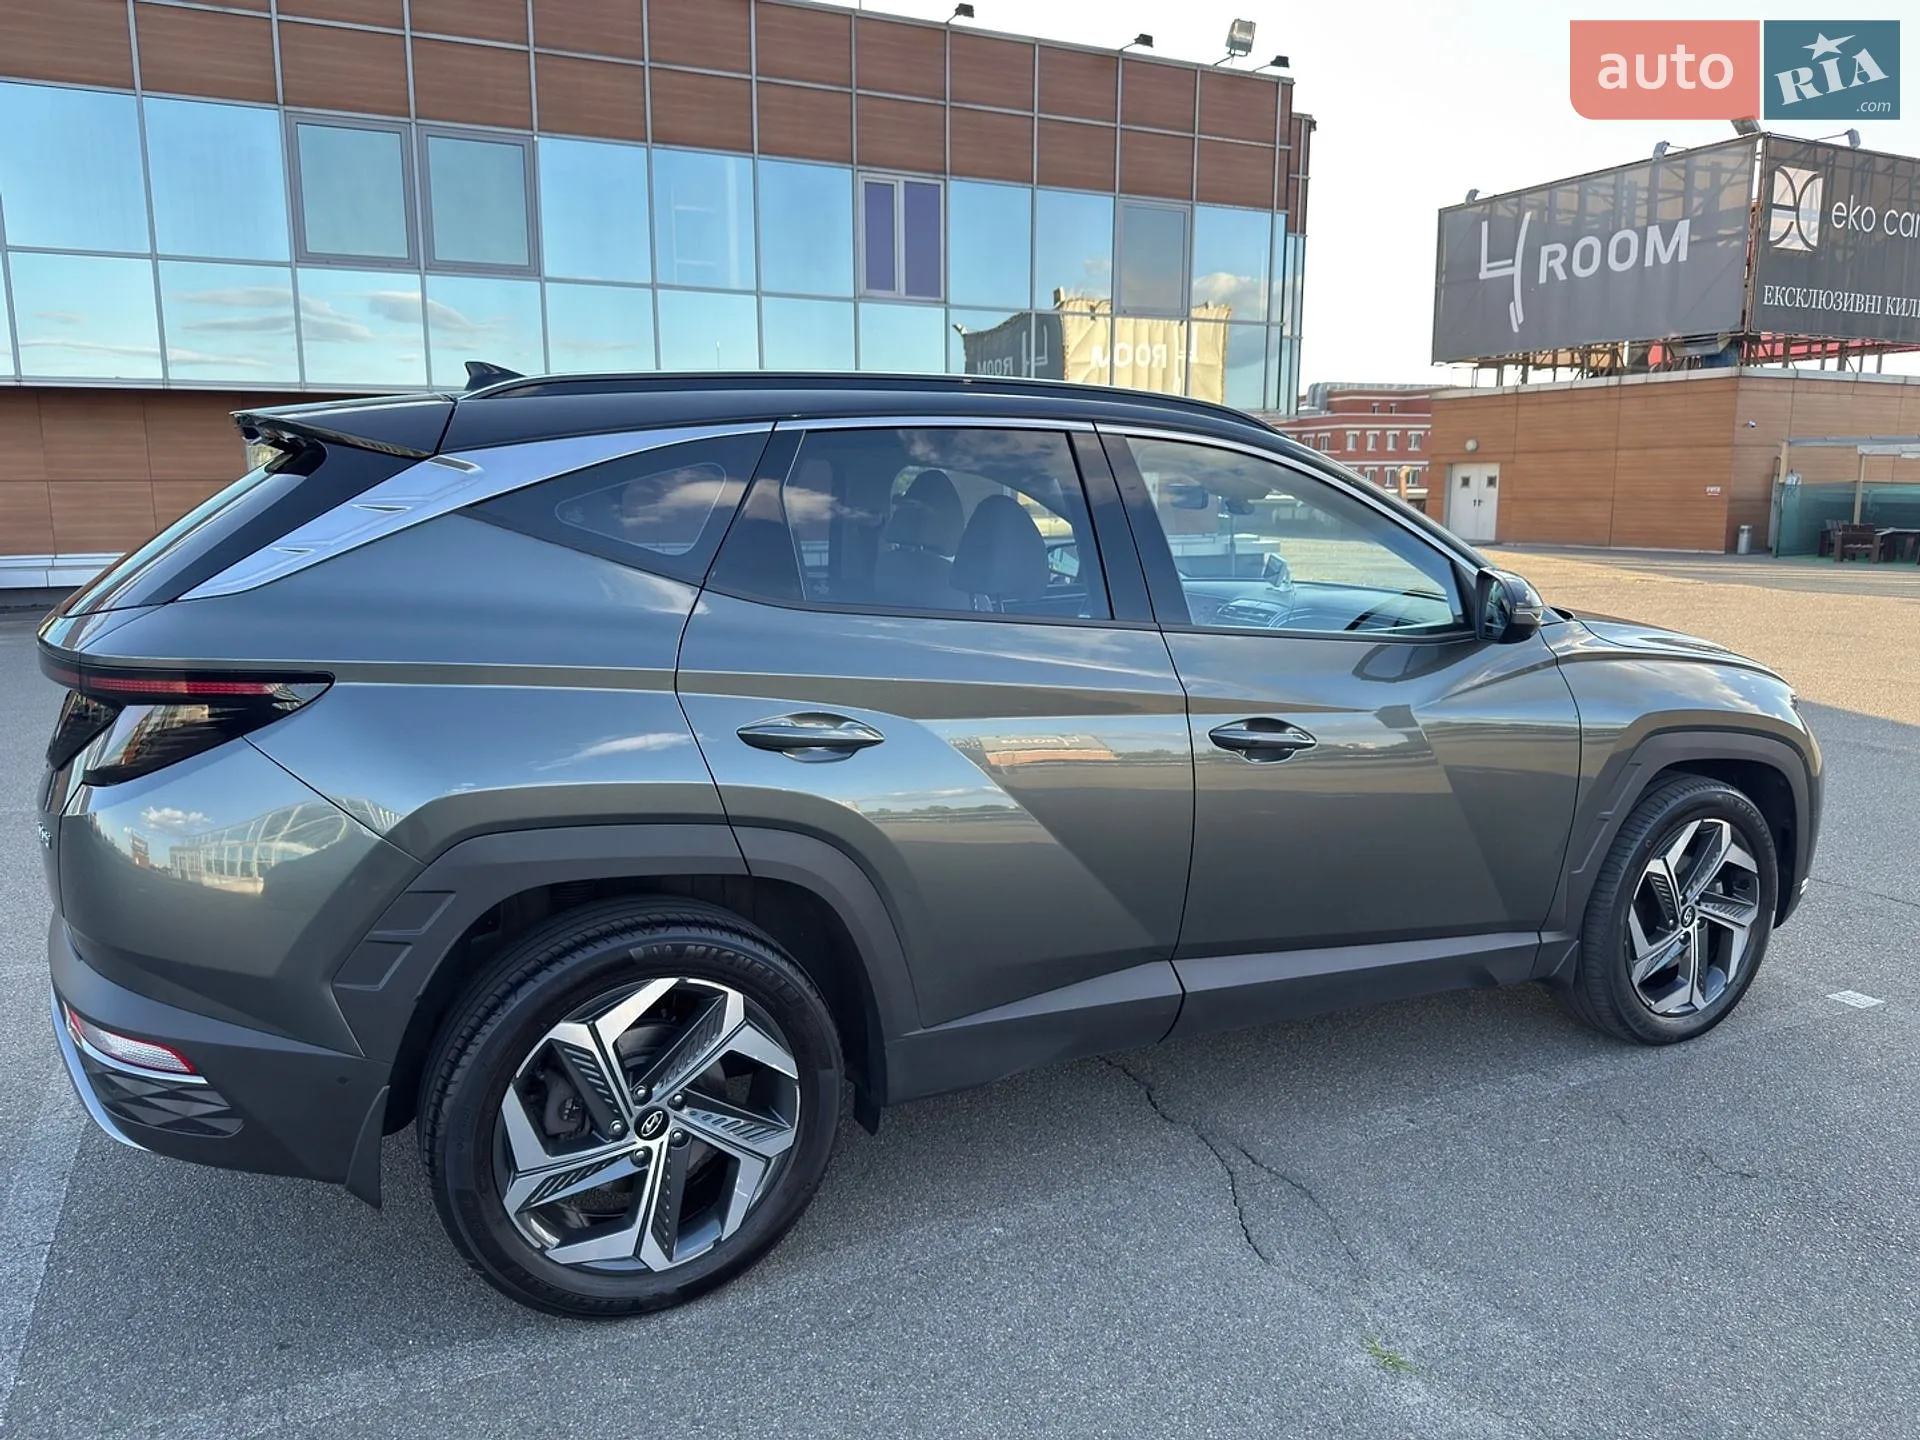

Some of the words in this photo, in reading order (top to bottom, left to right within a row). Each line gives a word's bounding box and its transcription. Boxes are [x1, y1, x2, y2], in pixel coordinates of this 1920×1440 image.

[1831, 194, 1876, 233] eko
[1538, 219, 1690, 284] ROOM
[1763, 285, 1882, 315] ЕКСКЛЮЗИВНІ
[1885, 295, 1920, 318] КИЛ
